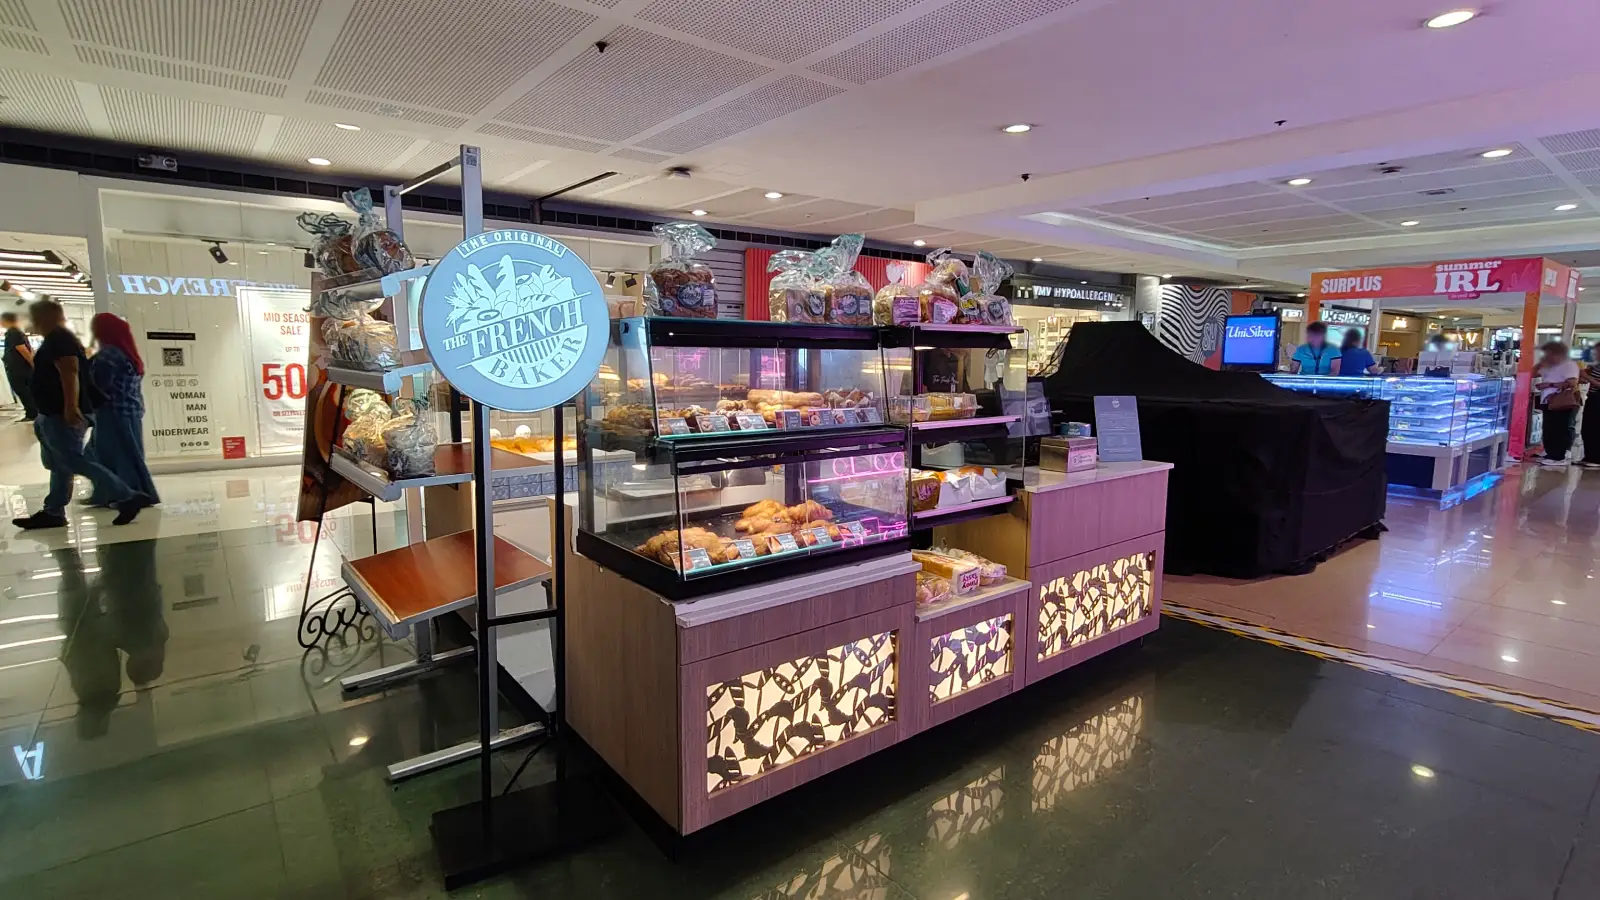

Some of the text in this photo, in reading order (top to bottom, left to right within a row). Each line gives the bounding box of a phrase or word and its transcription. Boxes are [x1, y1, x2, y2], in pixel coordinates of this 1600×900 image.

[463, 231, 562, 254] THE ORIGINAL
[1436, 260, 1502, 272] summer
[1320, 275, 1383, 294] SURPLUS
[1434, 270, 1500, 294] IRL
[263, 312, 311, 324] MID SEASO
[280, 325, 302, 336] SALE
[442, 299, 585, 361] THE FRENCH
[1226, 325, 1275, 338] UniSilver
[488, 336, 583, 385] BAKER
[170, 391, 206, 400] WOMAN
[186, 403, 207, 411] MAN
[187, 415, 208, 423] KIDS
[152, 427, 209, 437] UNDERWEAR
